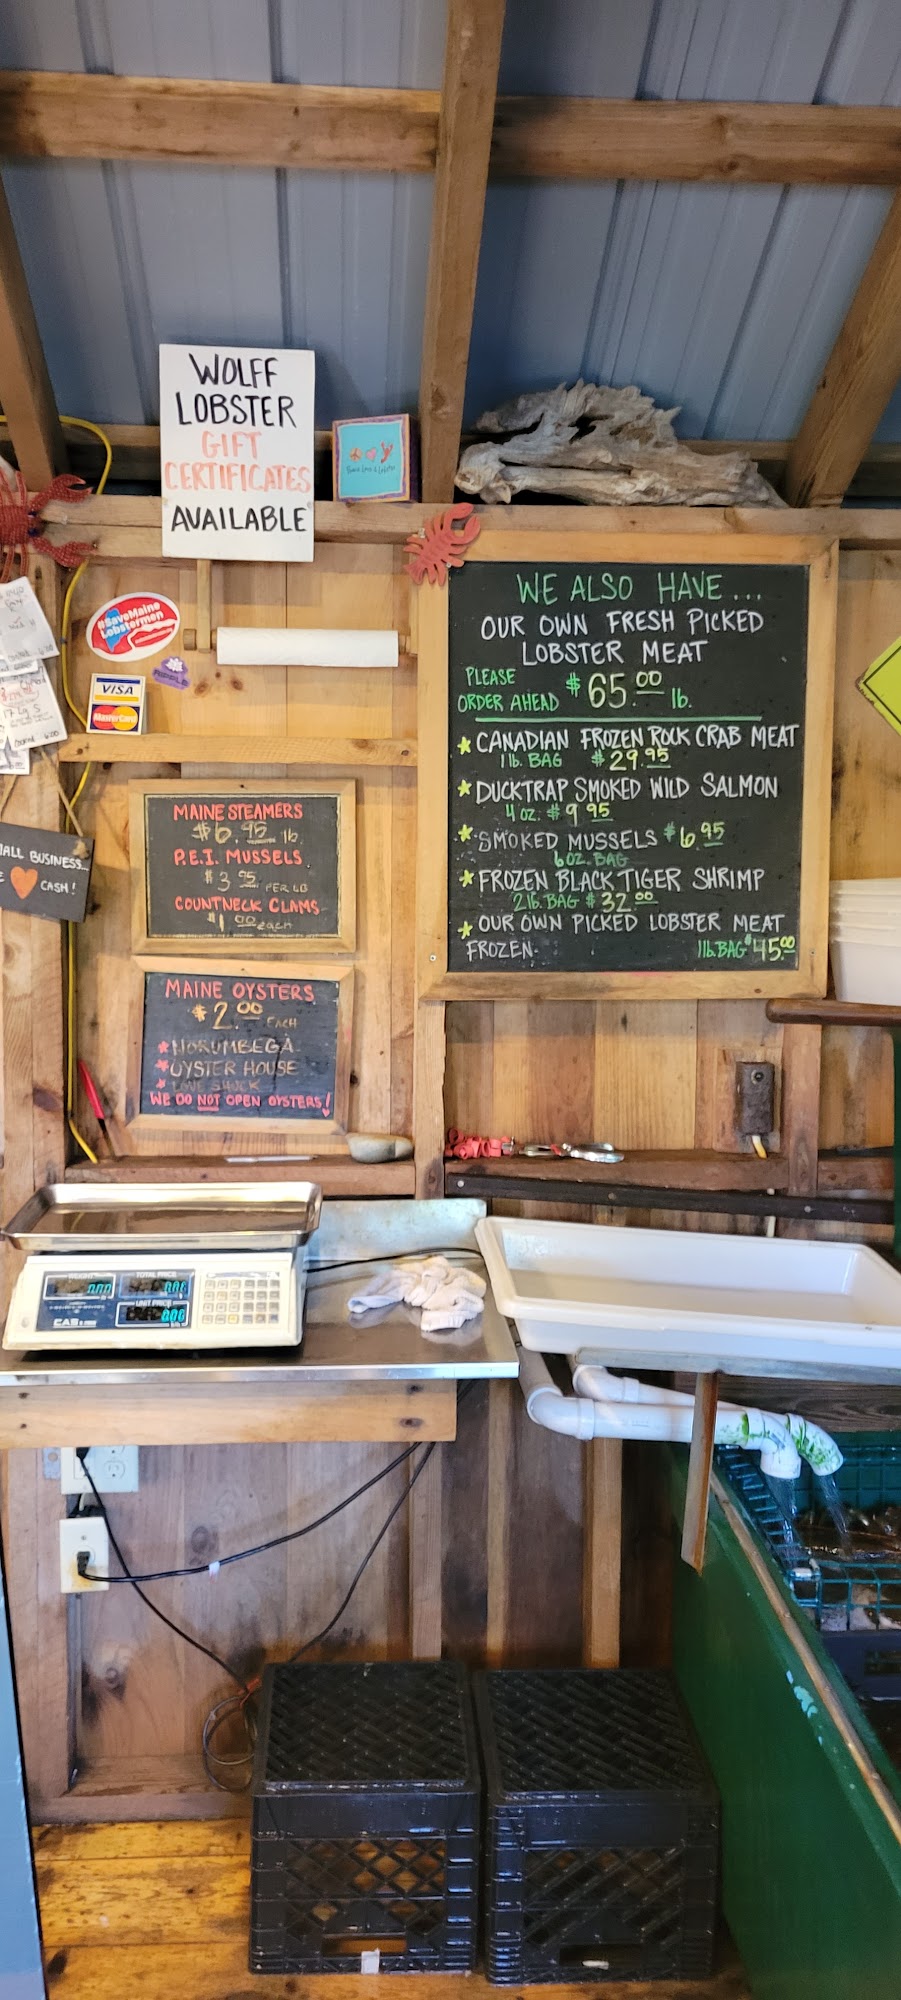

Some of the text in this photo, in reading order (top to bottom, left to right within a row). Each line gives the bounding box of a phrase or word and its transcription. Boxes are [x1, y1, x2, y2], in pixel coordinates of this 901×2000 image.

[189, 353, 278, 388] WOLFF
[176, 392, 296, 428] LOBSTER
[202, 431, 262, 459] GIFT
[165, 462, 311, 493] CERTIFICATES
[171, 505, 307, 532] AVAILABLE
[516, 572, 558, 606] WE
[570, 572, 633, 602] ALSO
[98, 602, 160, 629] #SaveMaine
[101, 611, 164, 639] Lobstermen
[481, 608, 764, 640] OUR OWN FRESH PICKED
[522, 640, 708, 666] LOBSTER MEAT
[465, 666, 517, 687] PLEASE
[103, 684, 133, 696] VISA
[457, 692, 560, 713] ORDER AHEAD
[93, 713, 138, 724] MasterCard
[476, 724, 799, 753] CANADIAN FROZEN ROCK CRAB MEAT
[528, 752, 562, 768] BAG
[476, 772, 778, 805] DUCKTRAP SMOKED WILD SALMON
[173, 802, 303, 821] MAINE STEAMERS
[478, 832, 558, 852] SMOKED
[568, 830, 657, 851] MUSSELS
[174, 848, 303, 866] P.E.I. MUSSELS
[593, 852, 629, 867] BAG
[266, 884, 289, 893] PER
[293, 884, 309, 893] LB
[478, 866, 765, 892] FROZEN BLACK TIGER SHRIMP
[175, 896, 320, 915] COUNTNECK CLAMS
[544, 894, 580, 909] BAG
[257, 920, 293, 932] each
[478, 913, 785, 934] OUR OWN PICKED LOBSTER MEAT
[466, 940, 534, 962] FROZEN
[165, 979, 315, 1002] MAINE OYSTERS
[267, 1016, 297, 1030] EACH
[172, 1038, 294, 1056] NORUMBEGA
[170, 1060, 299, 1079] OYSTER HOUSE
[150, 1092, 171, 1106] WE
[176, 1093, 193, 1106] DO
[197, 1094, 220, 1108] NOT
[226, 1094, 261, 1107] OPEN
